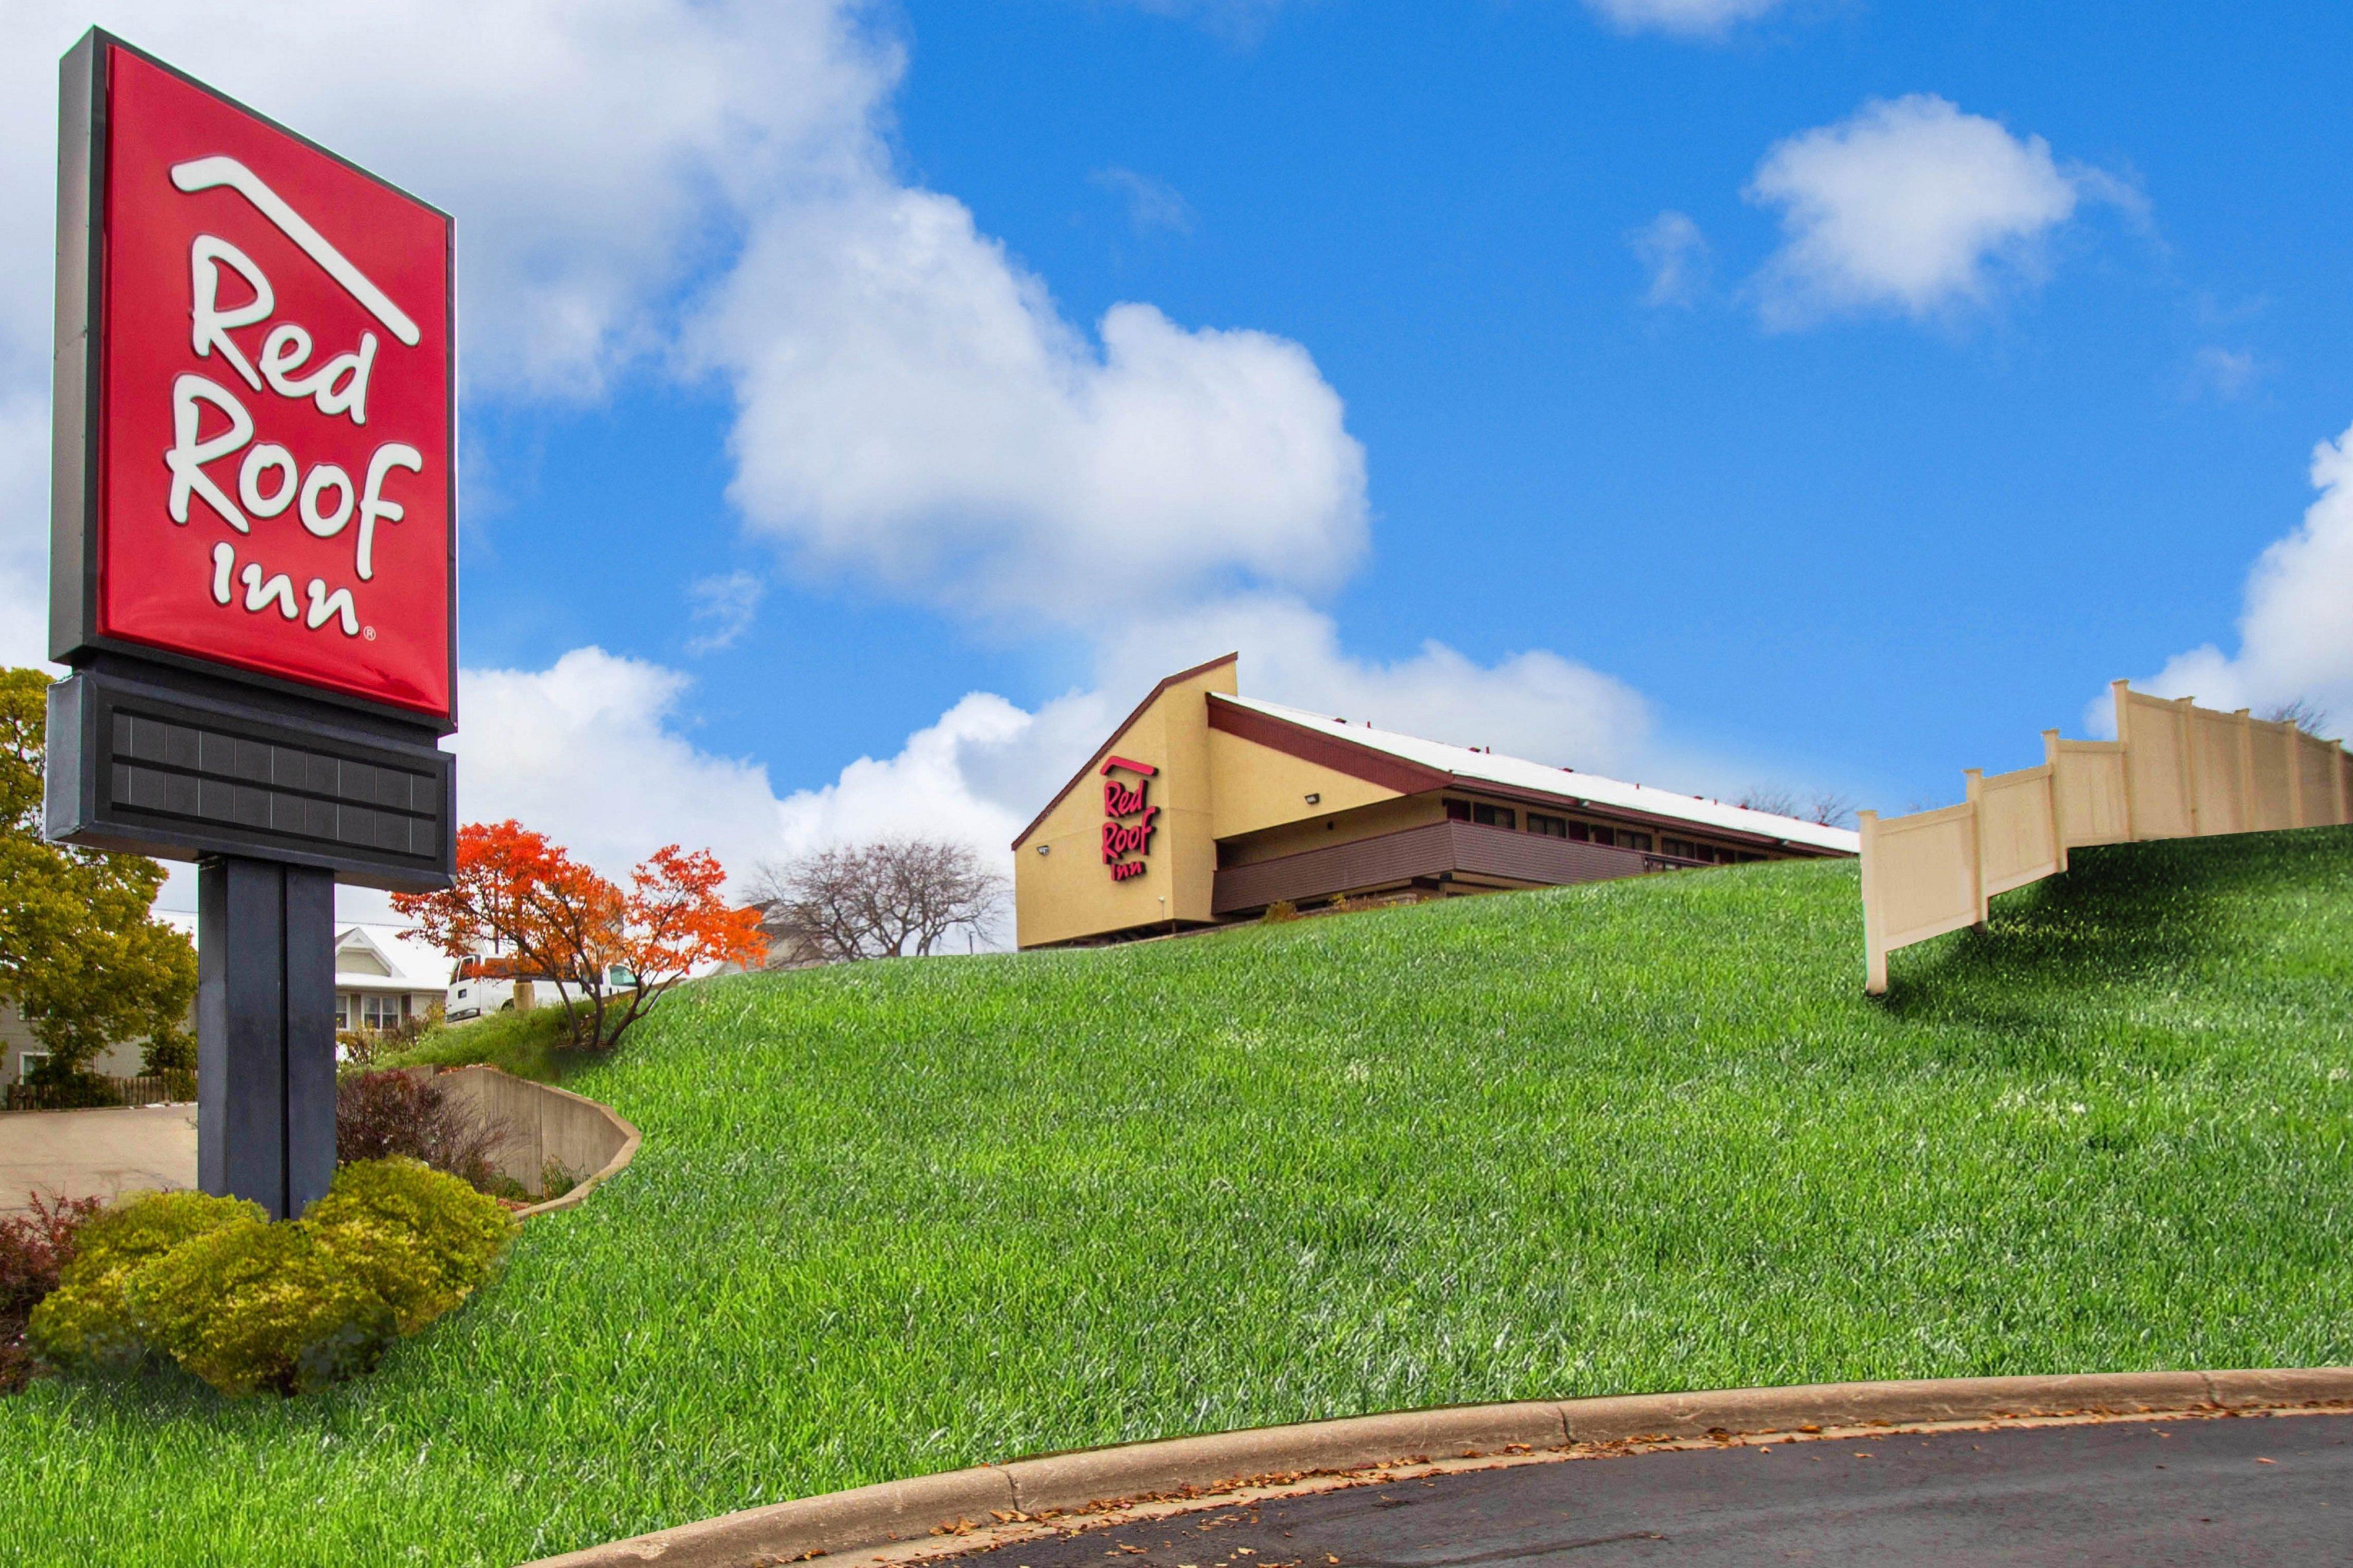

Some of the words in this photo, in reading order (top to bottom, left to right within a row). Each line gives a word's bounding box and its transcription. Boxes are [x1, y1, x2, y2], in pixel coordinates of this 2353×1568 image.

[192, 235, 376, 423] Red
[166, 374, 422, 579] Roof
[1102, 806, 1156, 864] Roof
[1104, 779, 1144, 818] Red
